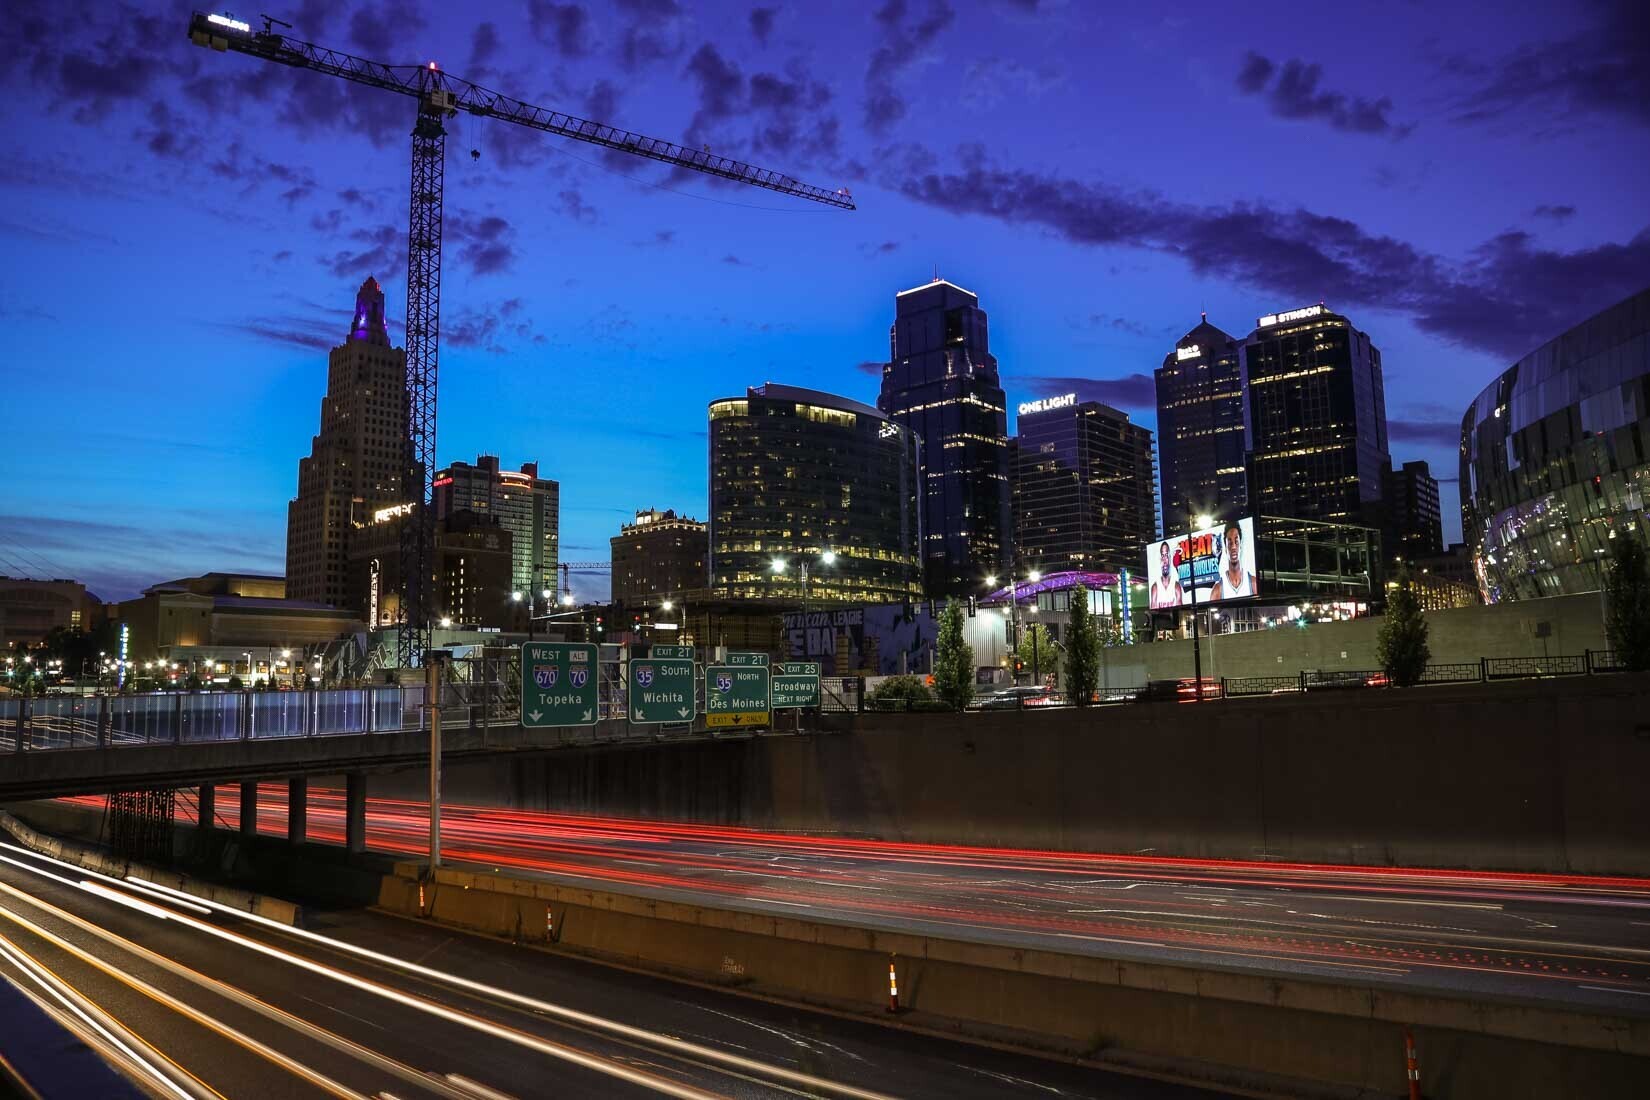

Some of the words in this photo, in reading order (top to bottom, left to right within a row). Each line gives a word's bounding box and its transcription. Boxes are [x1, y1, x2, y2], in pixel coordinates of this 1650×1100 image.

[1278, 306, 1320, 323] STINSON
[1019, 401, 1042, 415] ONE
[1043, 393, 1076, 410] LIGHT
[1178, 533, 1213, 561] HEAT
[1177, 557, 1219, 579] TIMBRWOLVES
[833, 609, 864, 626] LEAGUE
[531, 649, 561, 661] WEST
[572, 651, 586, 661] ALT
[656, 647, 673, 657] EXIT
[678, 647, 691, 658] 2T
[731, 655, 747, 664] EXIT
[751, 655, 764, 665] 2T
[661, 665, 690, 676] SOUTH
[787, 666, 801, 674] EXIT
[804, 665, 817, 674] 2S
[536, 671, 556, 684] 670
[571, 671, 586, 684] 70
[637, 671, 652, 683] 35
[737, 673, 760, 682] NORTH
[718, 678, 732, 689] 35
[774, 681, 817, 694] Broadway
[538, 693, 582, 707] Topeka
[643, 691, 683, 704] Wichita
[710, 698, 728, 709] Des
[732, 697, 765, 708] Moines
[778, 695, 794, 704] NEXT
[795, 695, 813, 703] RIGHT
[712, 716, 727, 724] EXIT
[746, 715, 764, 723] ONLY
